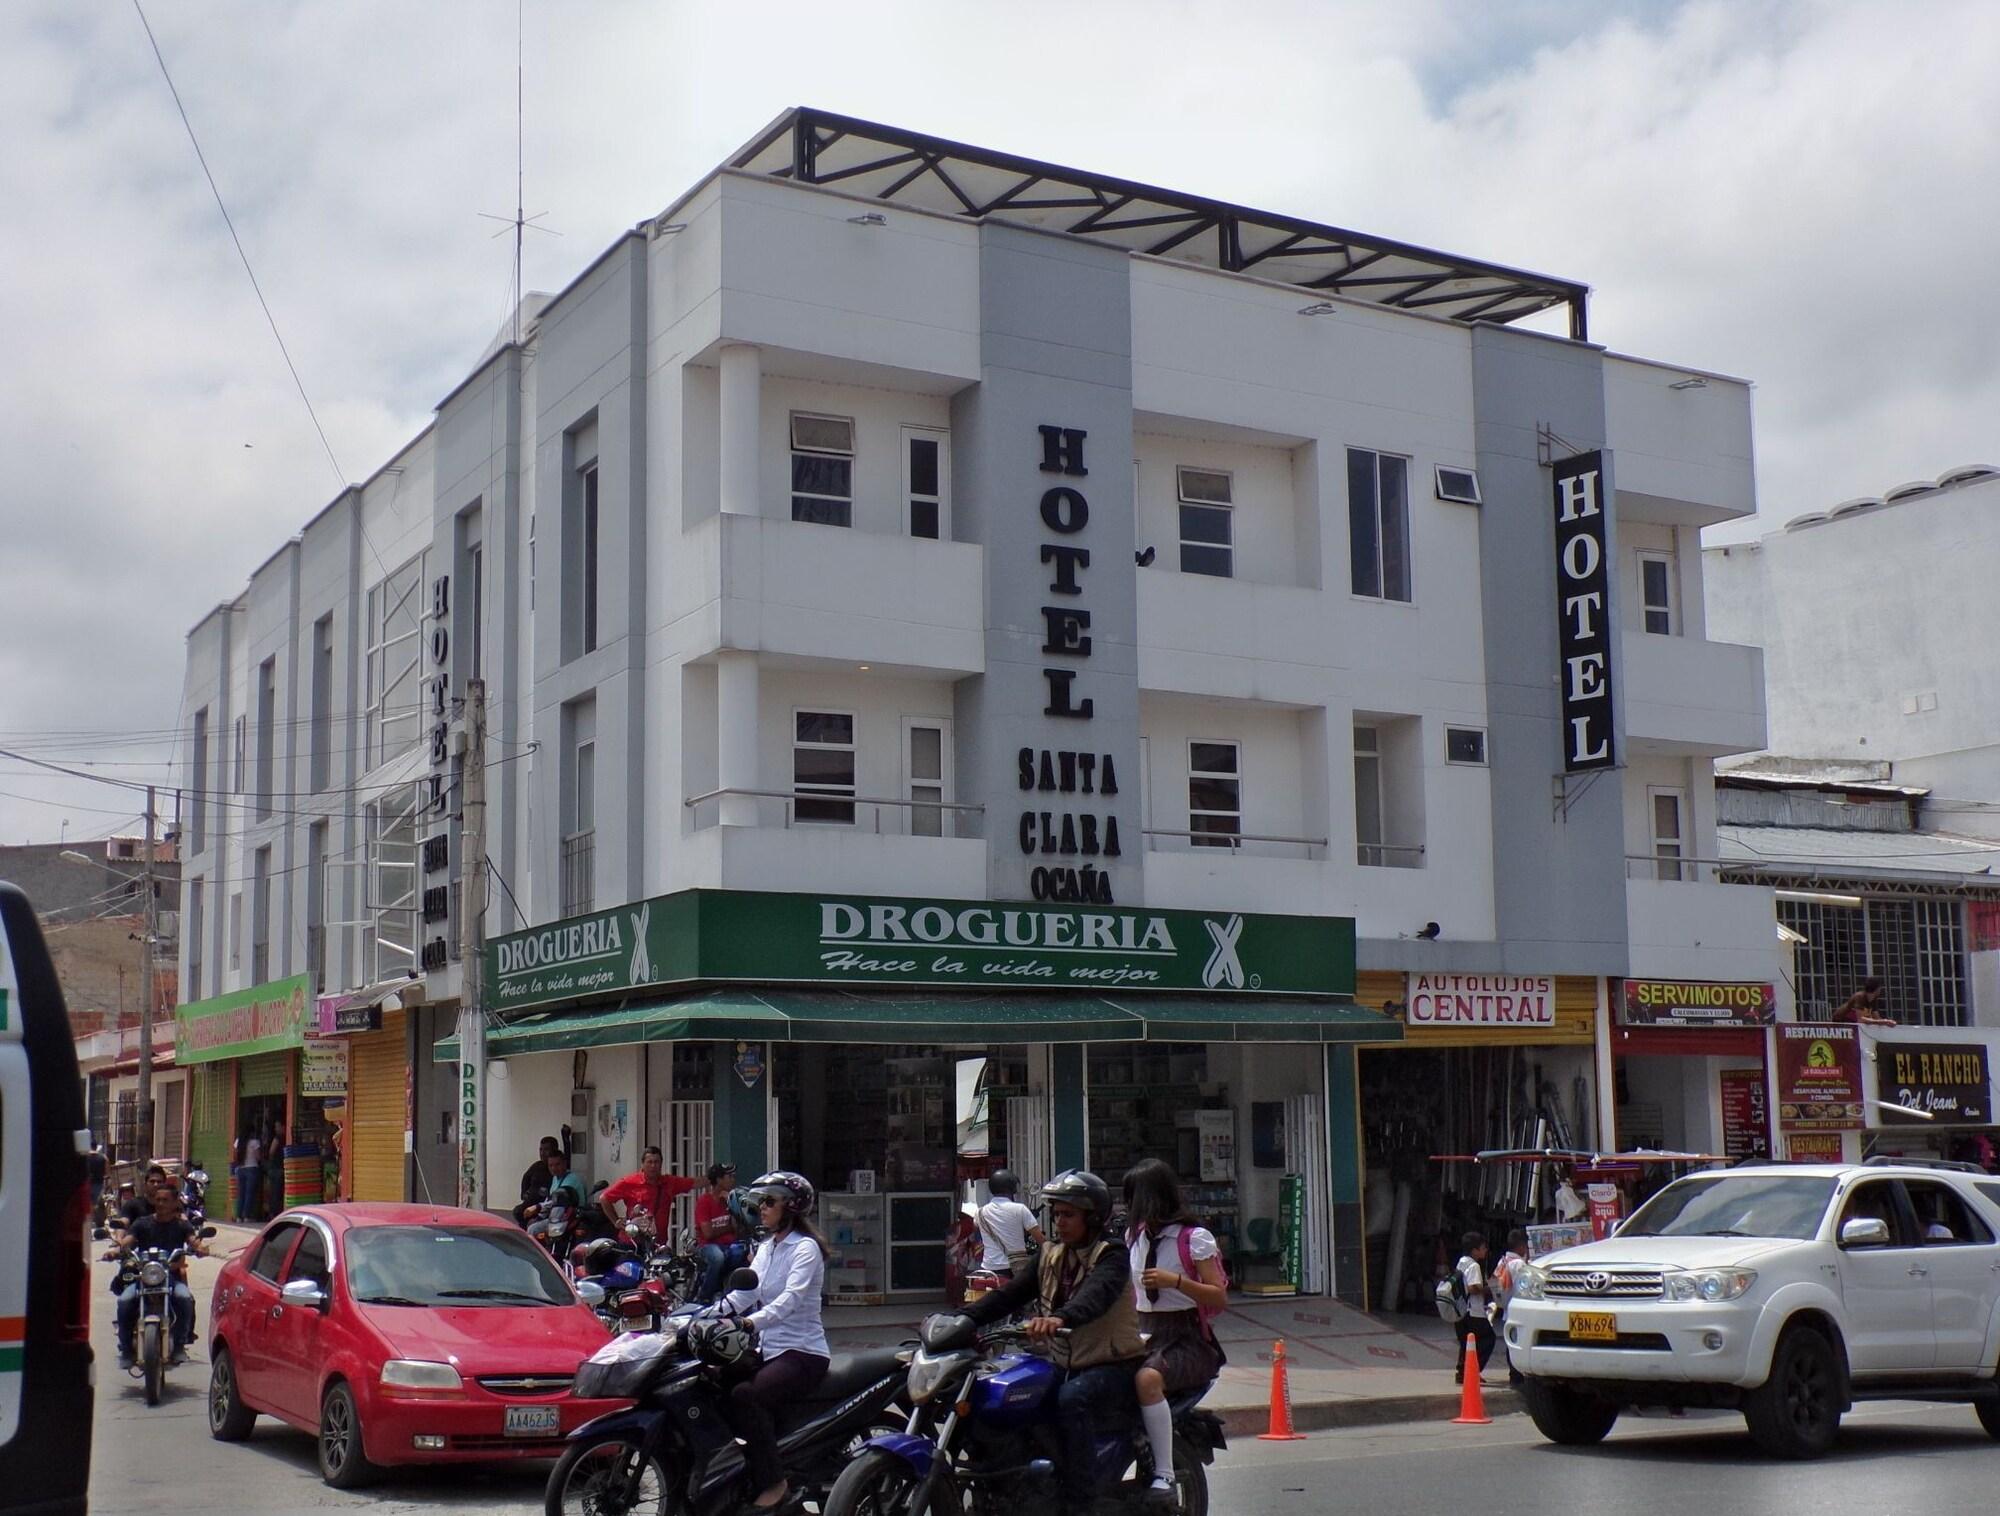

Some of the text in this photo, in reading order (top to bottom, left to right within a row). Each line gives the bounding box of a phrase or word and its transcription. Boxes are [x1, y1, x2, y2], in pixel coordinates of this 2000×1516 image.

[1038, 425, 1094, 719] HOTEL
[1558, 470, 1608, 762] HOTEL
[1018, 747, 1119, 794] SANTA
[1019, 811, 1122, 857] CLARA
[1031, 863, 1114, 904] OCAÑA
[819, 902, 1177, 950] DROGUERIA
[497, 915, 622, 974] DROGUERIA
[498, 967, 615, 998] Hace la vida mejor
[820, 950, 1162, 984] Hace la vida mejor
[1417, 975, 1550, 993] AUTOLUJOS
[1637, 983, 1763, 1006] SERVIMOTOS
[1412, 994, 1553, 1022] CENTRAL
[1785, 1027, 1854, 1039] RESTAURANTE
[1895, 1053, 1981, 1085] EL RANCHO
[1898, 1088, 1959, 1111] Del Jeans
[1570, 1317, 1614, 1333] KBN 694
